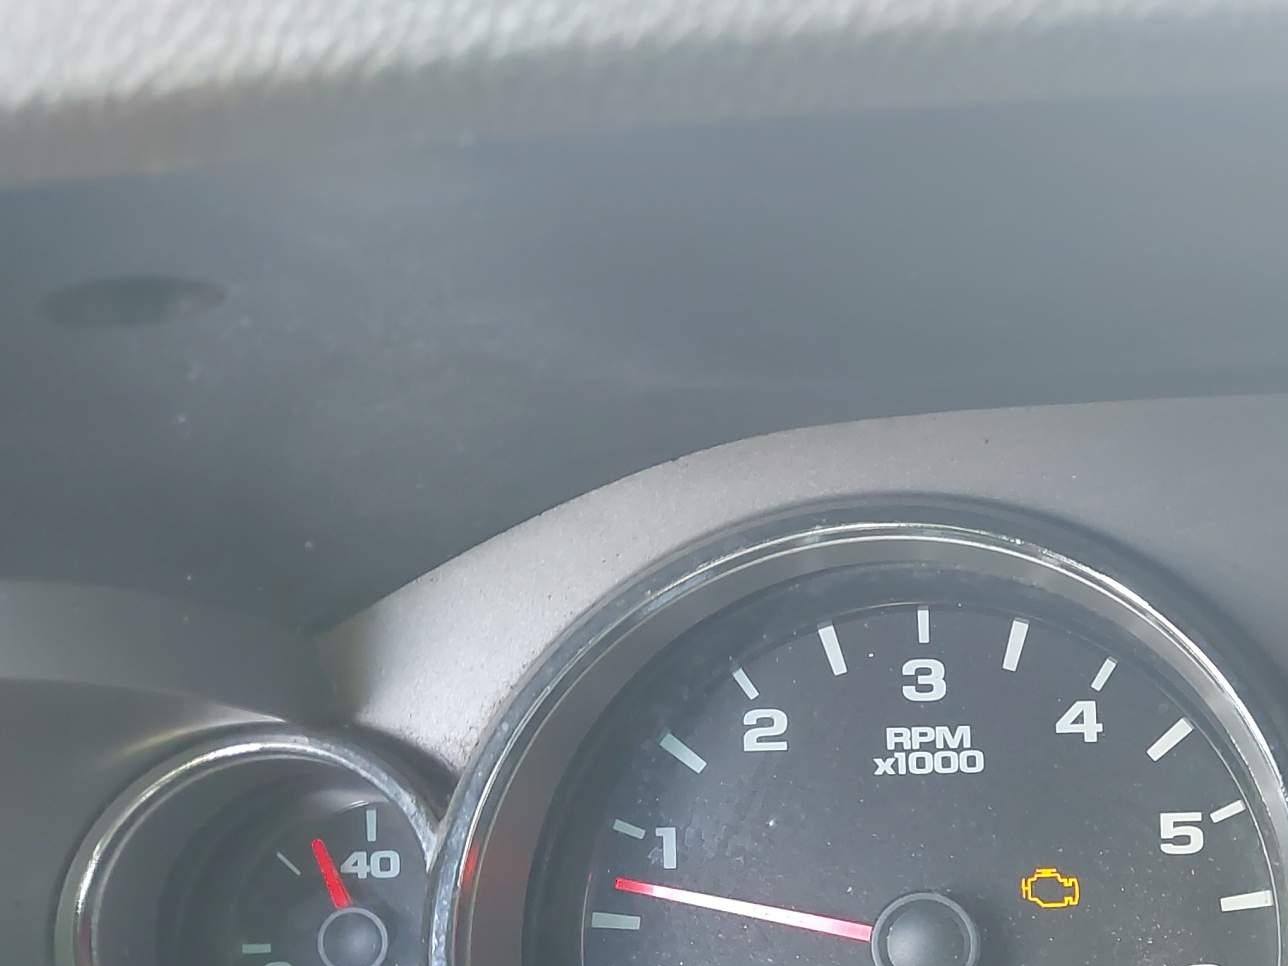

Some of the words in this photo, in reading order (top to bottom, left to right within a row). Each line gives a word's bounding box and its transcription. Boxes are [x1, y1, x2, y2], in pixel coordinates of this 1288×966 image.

[903, 659, 946, 701] 3
[744, 709, 787, 751] 2
[887, 726, 971, 750] RPM
[1056, 701, 1102, 742] 4
[874, 751, 984, 775] x1000
[656, 828, 676, 868] 1
[1160, 812, 1203, 854] 5
[343, 851, 400, 878] 40
